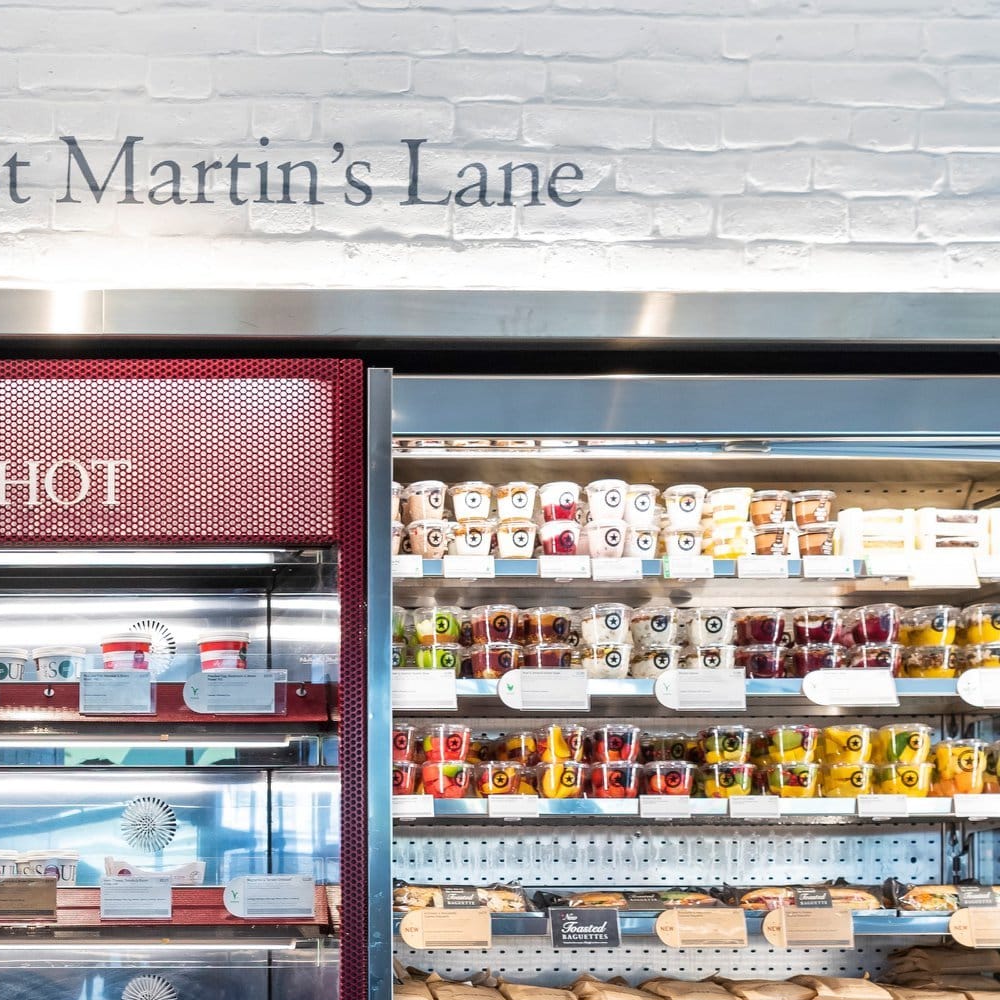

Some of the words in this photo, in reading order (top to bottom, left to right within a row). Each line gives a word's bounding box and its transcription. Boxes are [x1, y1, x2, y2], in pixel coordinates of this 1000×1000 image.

[59, 135, 372, 205] Martin's
[400, 138, 583, 208] Lane
[562, 921, 608, 932] Toasted
